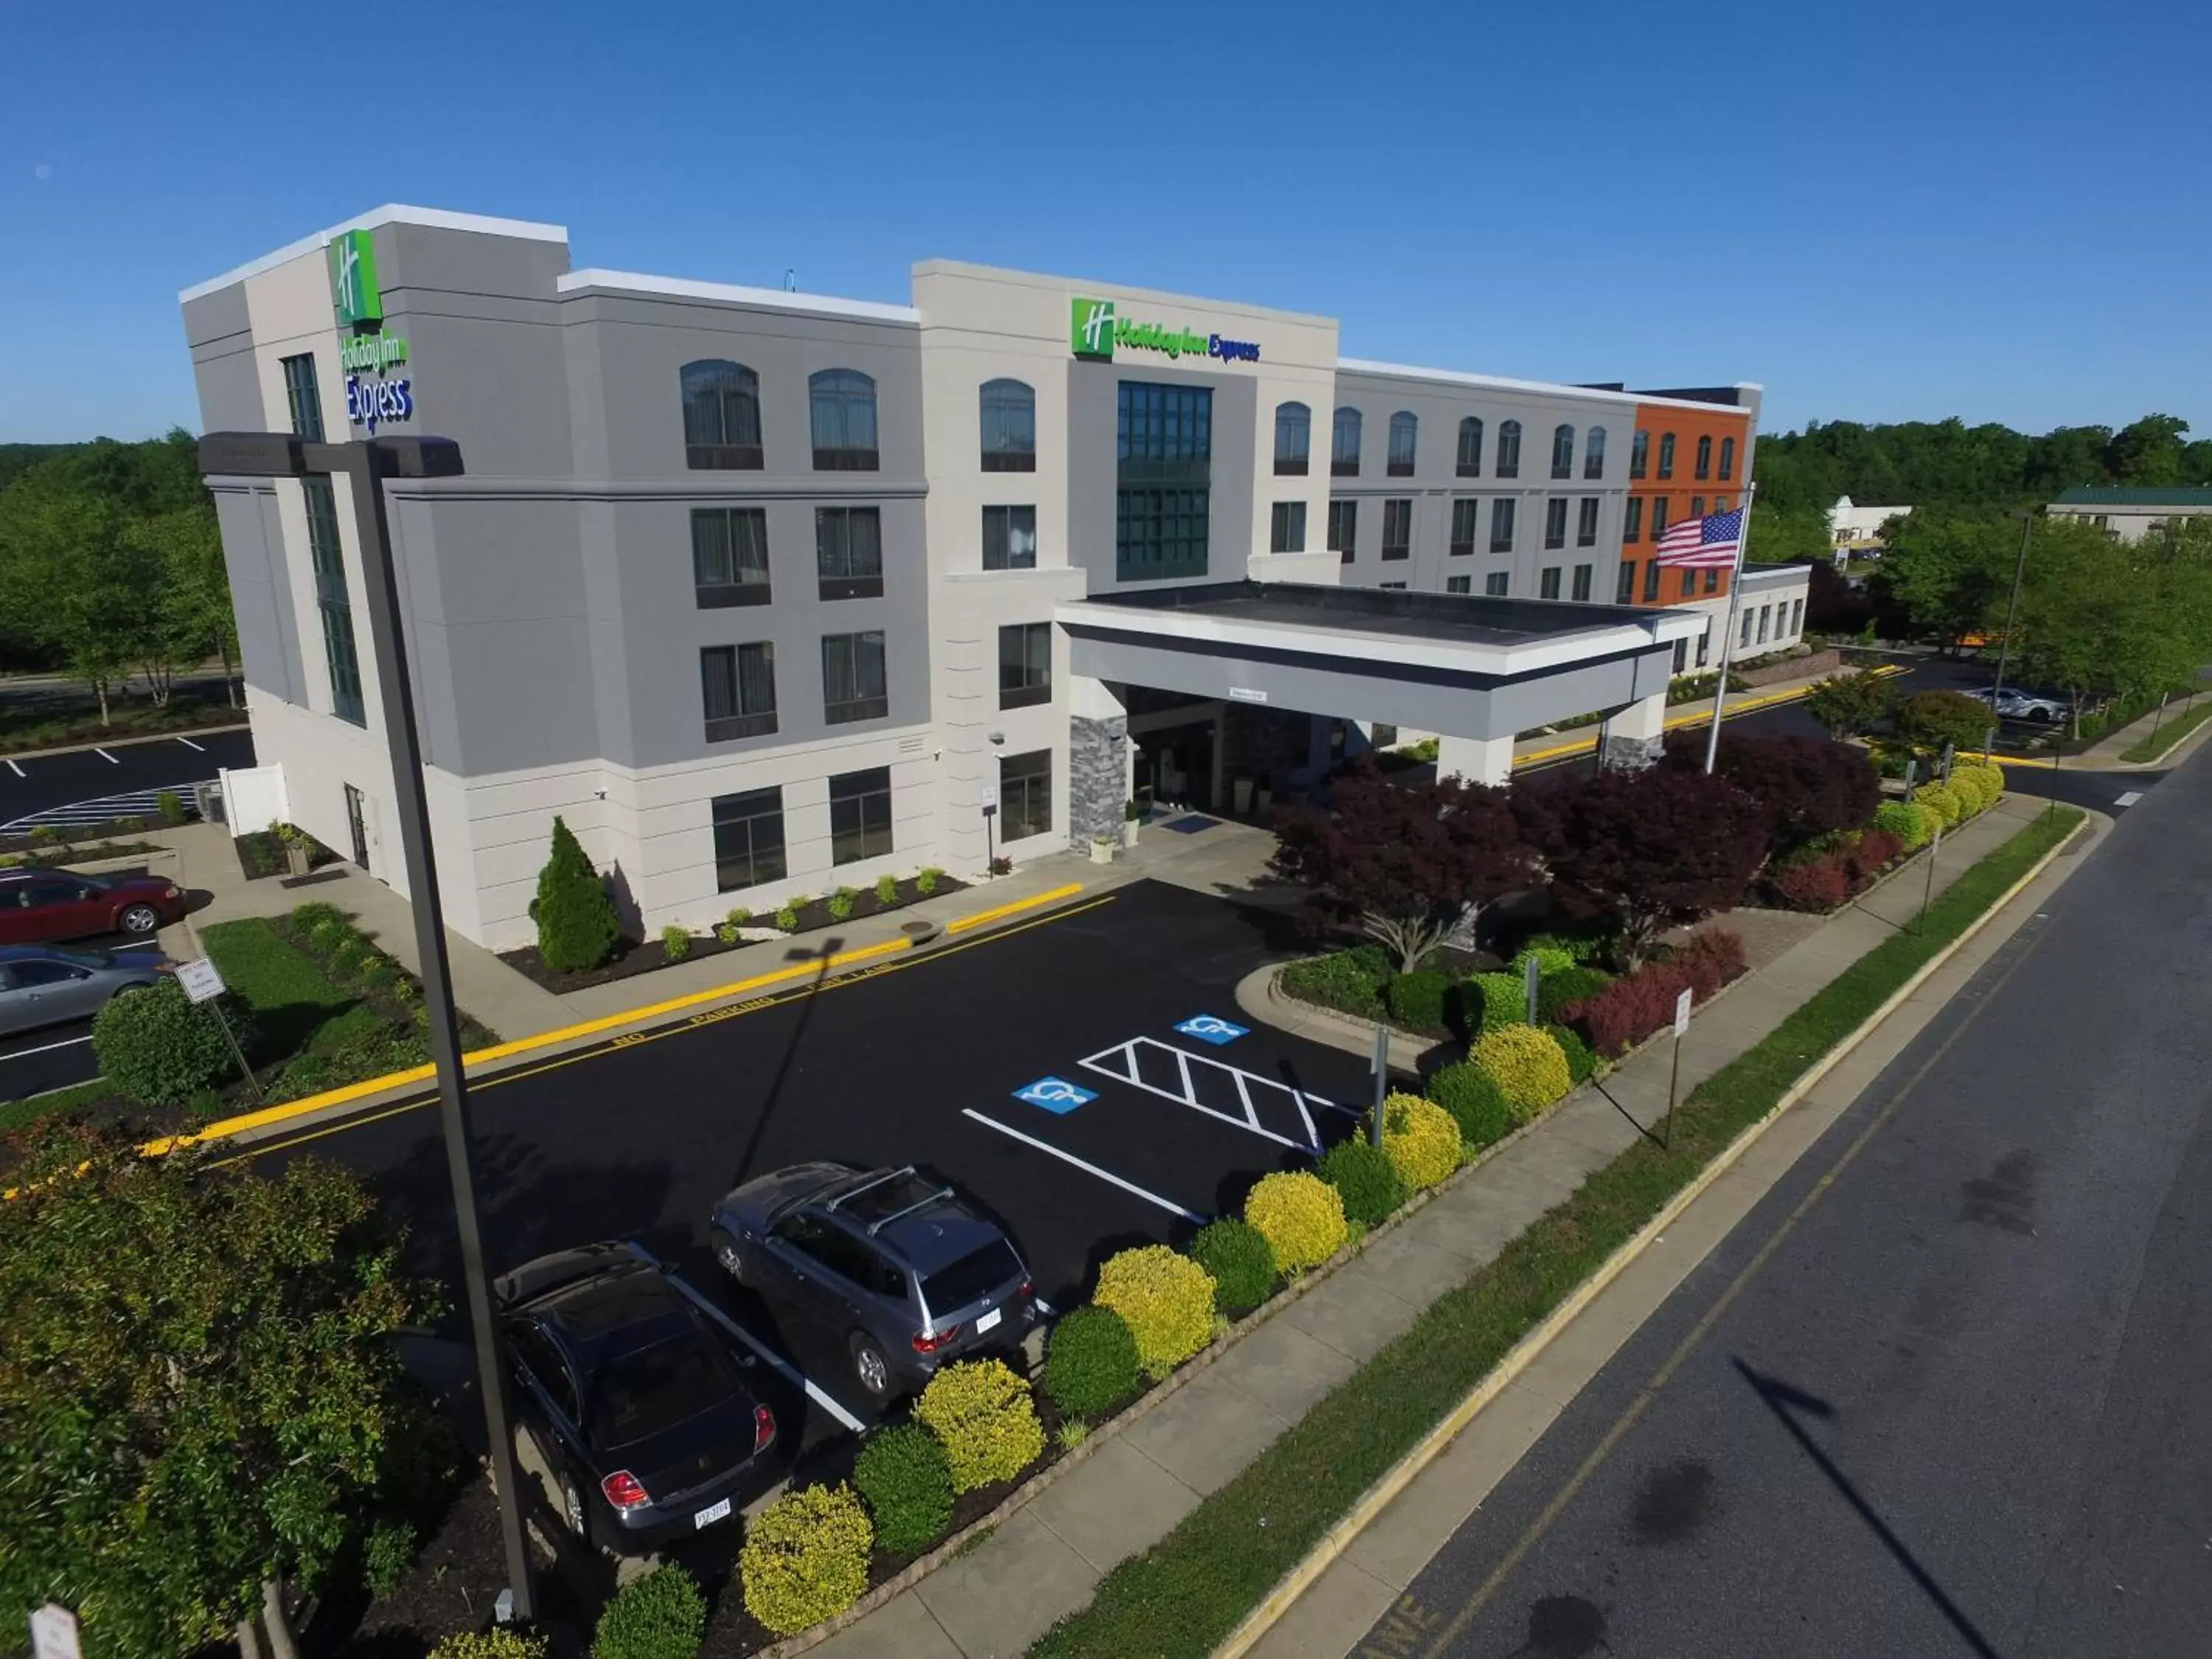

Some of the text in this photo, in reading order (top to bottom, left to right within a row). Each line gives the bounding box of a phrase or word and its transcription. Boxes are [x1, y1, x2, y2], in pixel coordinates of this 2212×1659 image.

[339, 333, 381, 372] Holiday
[1208, 333, 1261, 364] Express
[344, 375, 411, 432] Express
[613, 1032, 646, 1046] NO
[689, 995, 776, 1024] PARKING
